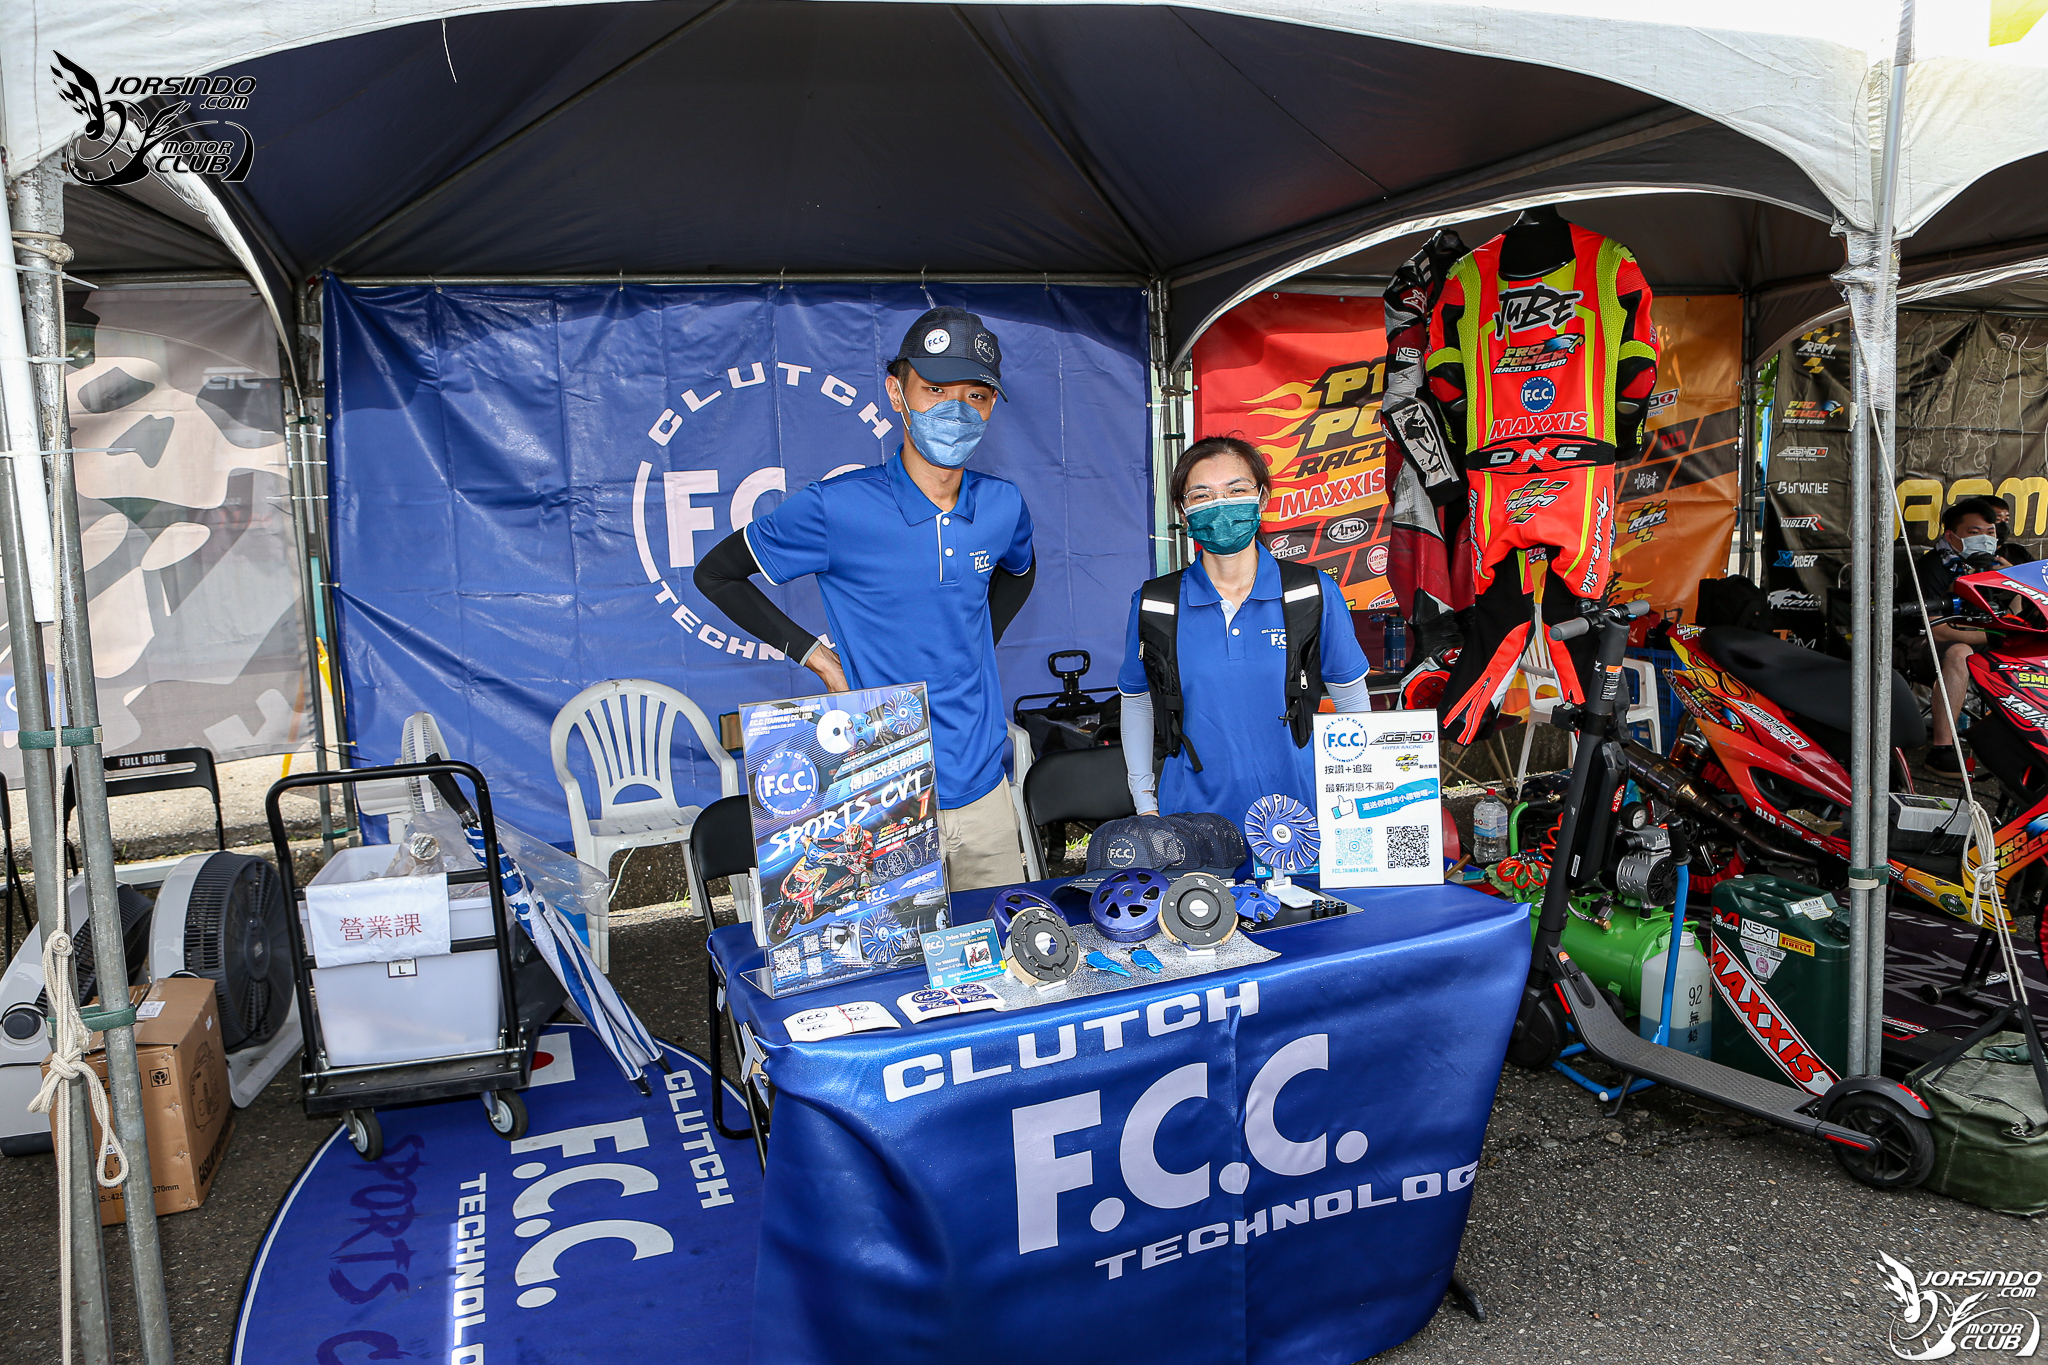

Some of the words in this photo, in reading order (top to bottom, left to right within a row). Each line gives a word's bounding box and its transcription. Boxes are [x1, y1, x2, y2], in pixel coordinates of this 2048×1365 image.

[1497, 348, 1568, 367] POWER
[1503, 344, 1546, 357] PRO
[1798, 341, 1837, 355] RPM
[1493, 364, 1532, 374] RACING
[1534, 358, 1568, 371] TEAM
[648, 361, 893, 446] CLUTCH
[1524, 387, 1552, 402] F.C.C.
[1784, 409, 1830, 418] POWER
[1489, 411, 1589, 440] MAXXIS
[1660, 429, 1687, 451] DID
[1279, 467, 1386, 521] MAXXIS
[1506, 494, 1559, 512] RPM
[1629, 509, 1667, 530] RPM
[1331, 523, 1363, 538] Arai
[1326, 717, 1364, 730] CLUTCH
[1702, 706, 1720, 724] TEAM
[1327, 732, 1364, 748] F.C.C.
[119, 755, 141, 767] FULL
[142, 753, 167, 765] BORE
[760, 751, 810, 773] CLUTCH
[843, 750, 866, 763] YAMAHA
[763, 770, 813, 798] F.C.C.
[1325, 782, 1394, 793] 最新消息不漏勾
[763, 791, 815, 816] TECHNOLOGY
[766, 792, 872, 864] SPORTS
[880, 767, 927, 809] CVT
[1755, 805, 1777, 825] DID
[1109, 848, 1133, 859] F.C.C.
[866, 887, 890, 905] F.C.C.
[338, 913, 423, 941] 營業課
[945, 934, 959, 942] Drive
[976, 927, 992, 936] Pulley
[1742, 920, 1778, 940] NEXT
[1781, 936, 1812, 953] PIRELLI
[1688, 984, 1703, 1007] 92
[799, 1011, 826, 1023] F.C.C.
[1712, 936, 1825, 1083] MAXXIS
[1687, 1010, 1700, 1044] 無鉛
[882, 981, 1260, 1102] CLUTCH
[663, 1069, 736, 1210] CLUTCH
[1011, 1033, 1369, 1255] F.C.C.
[509, 1116, 675, 1309] F.C.C.
[1094, 1160, 1480, 1281] TECHNOLOG
[450, 1172, 488, 1365] TECHNOLO
